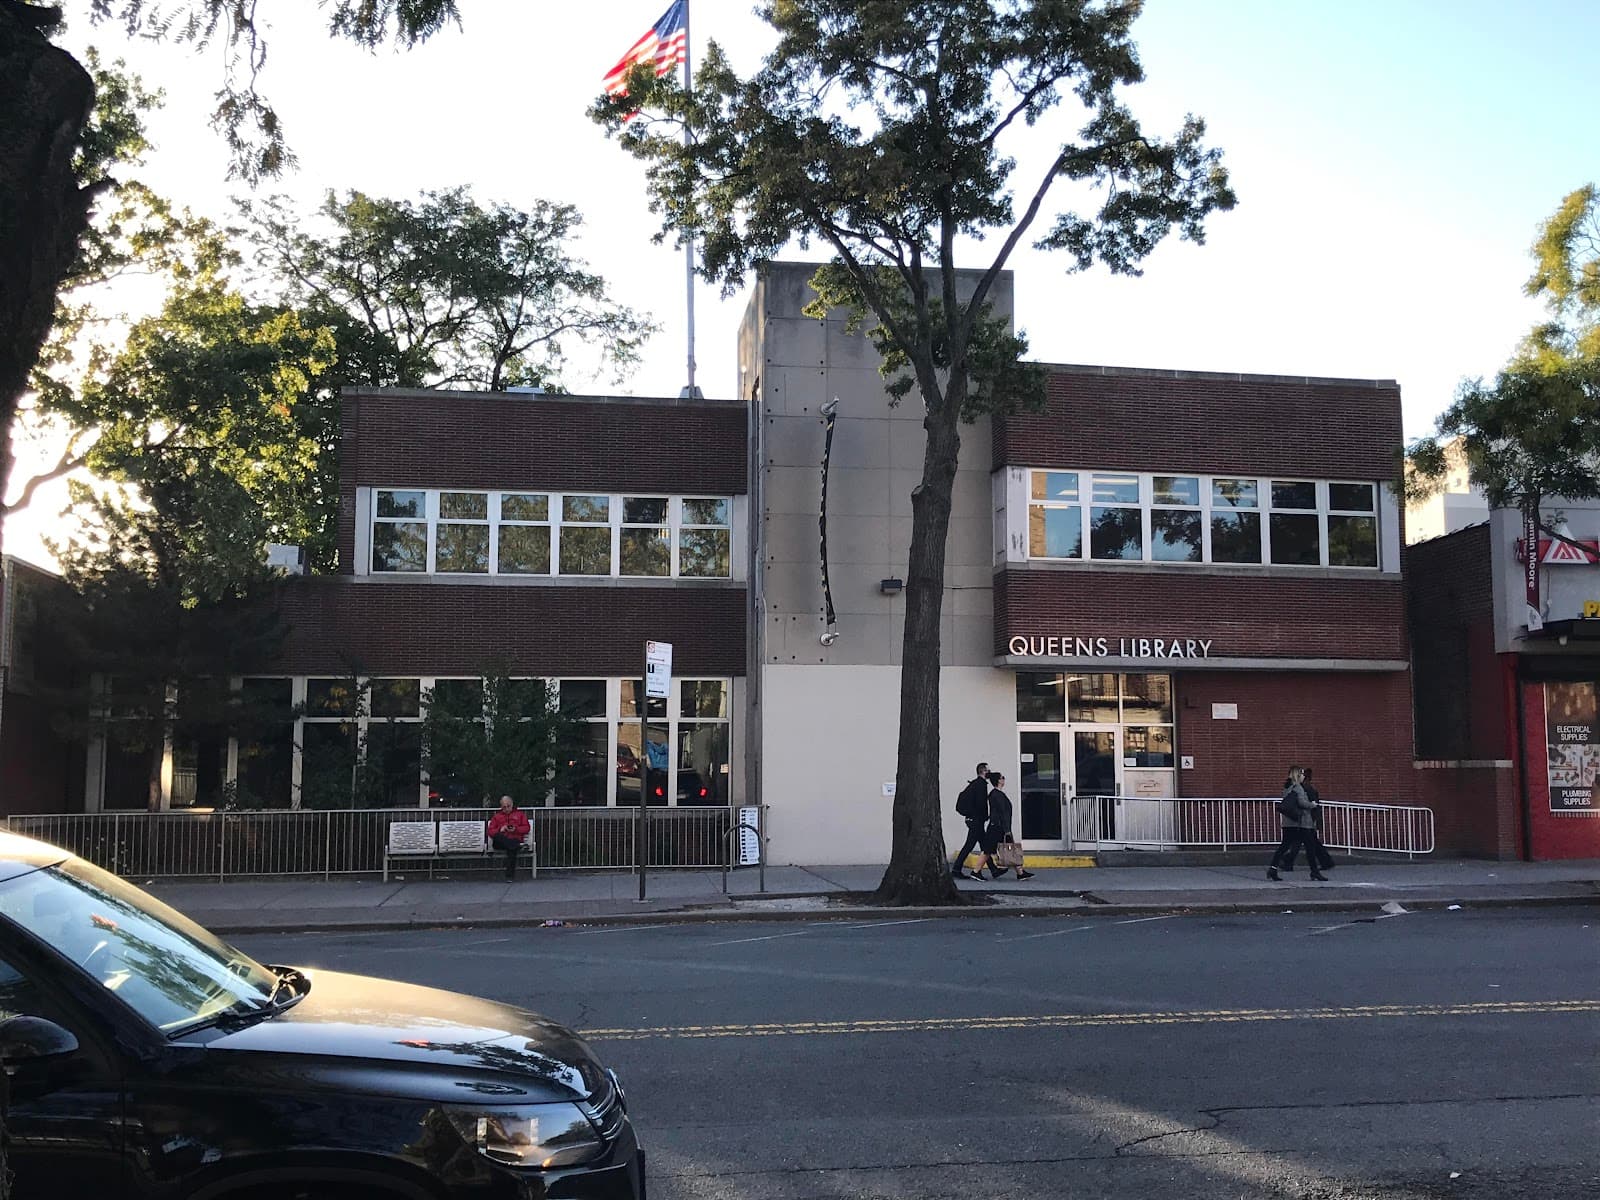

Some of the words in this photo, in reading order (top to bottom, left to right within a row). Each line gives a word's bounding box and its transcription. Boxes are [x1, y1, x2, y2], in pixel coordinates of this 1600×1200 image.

[1528, 552, 1537, 588] Moore
[1009, 635, 1108, 657] QUEENS
[1119, 638, 1213, 659] LIBRARY
[1556, 725, 1592, 734] ELECTRICAL
[1560, 733, 1588, 741] SUPPLIES
[1561, 790, 1592, 798] PLUMBING
[1563, 798, 1591, 806] SUPPLIES
